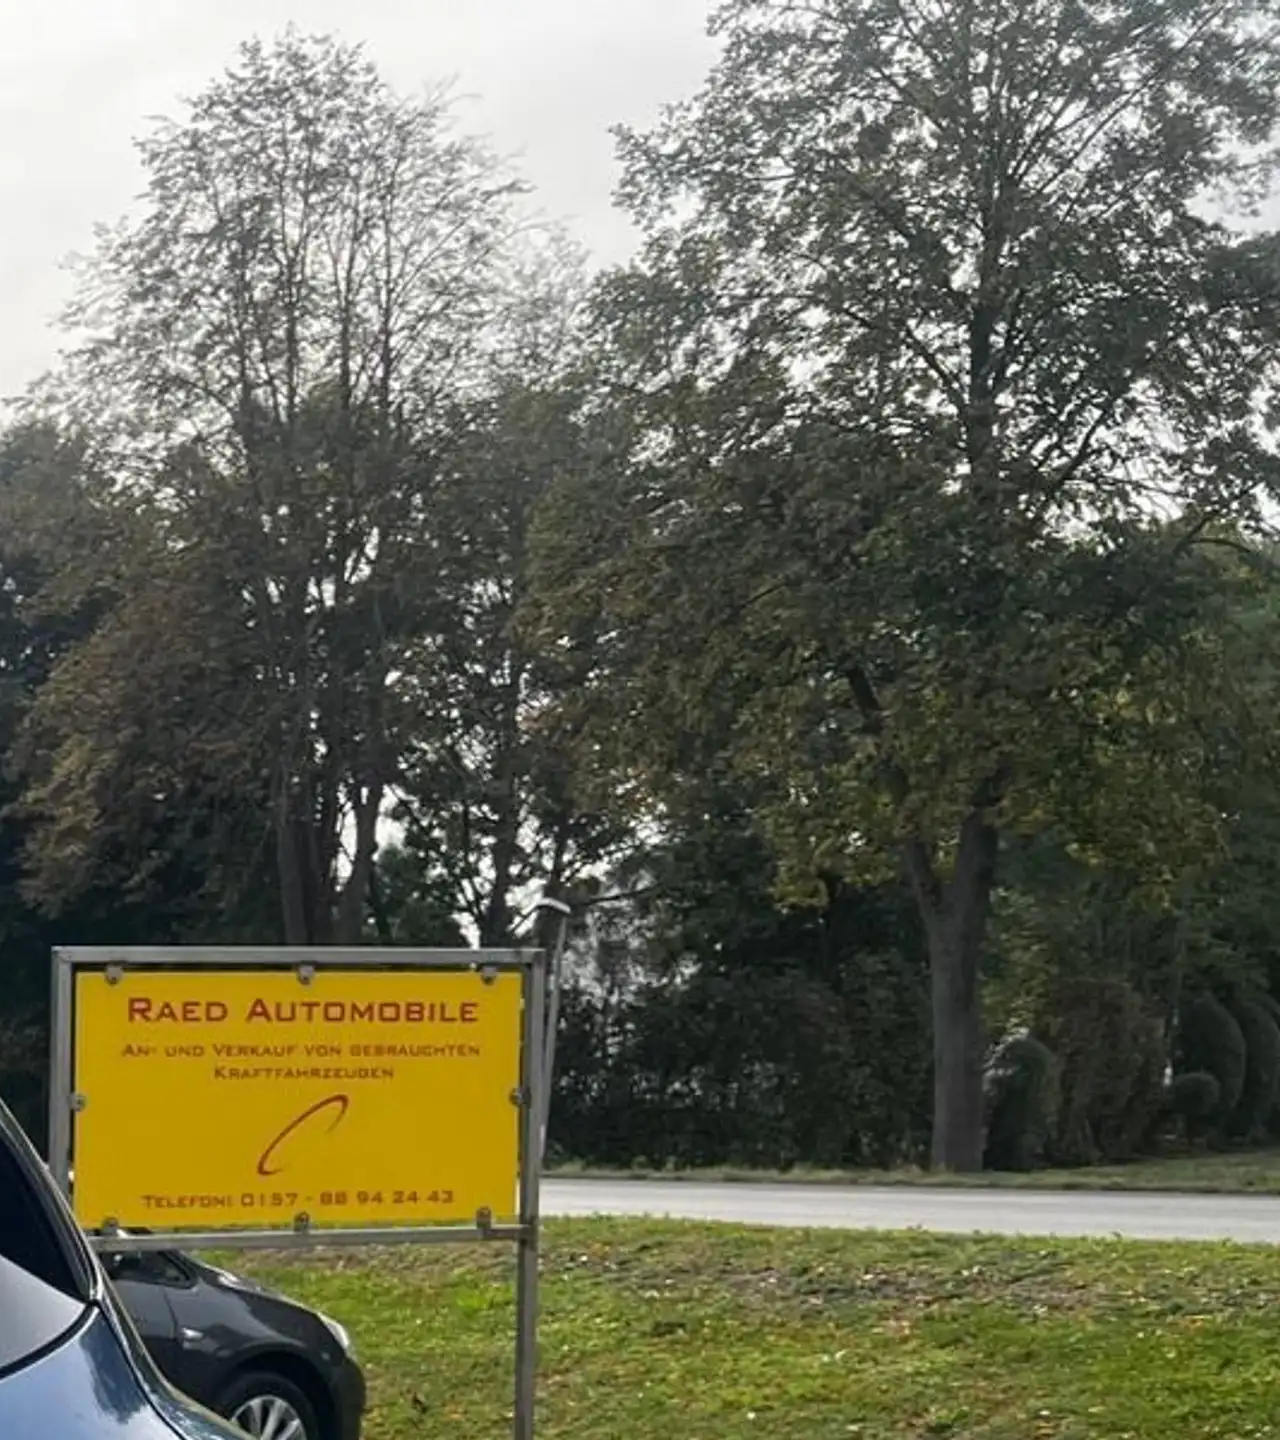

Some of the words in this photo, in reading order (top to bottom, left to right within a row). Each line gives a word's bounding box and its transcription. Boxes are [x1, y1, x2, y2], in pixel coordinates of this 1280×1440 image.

[127, 997, 228, 1023] RAED
[245, 997, 480, 1023] AUTOMOBILE
[164, 1044, 205, 1057] UND
[211, 1043, 297, 1057] VERKAUF
[303, 1043, 342, 1057] VON
[349, 1044, 481, 1057] GEBRAUCHTEN
[213, 1066, 395, 1080] KRAFTFAHRZEUGEN
[240, 1192, 299, 1207] 0157
[357, 1190, 384, 1204] 94
